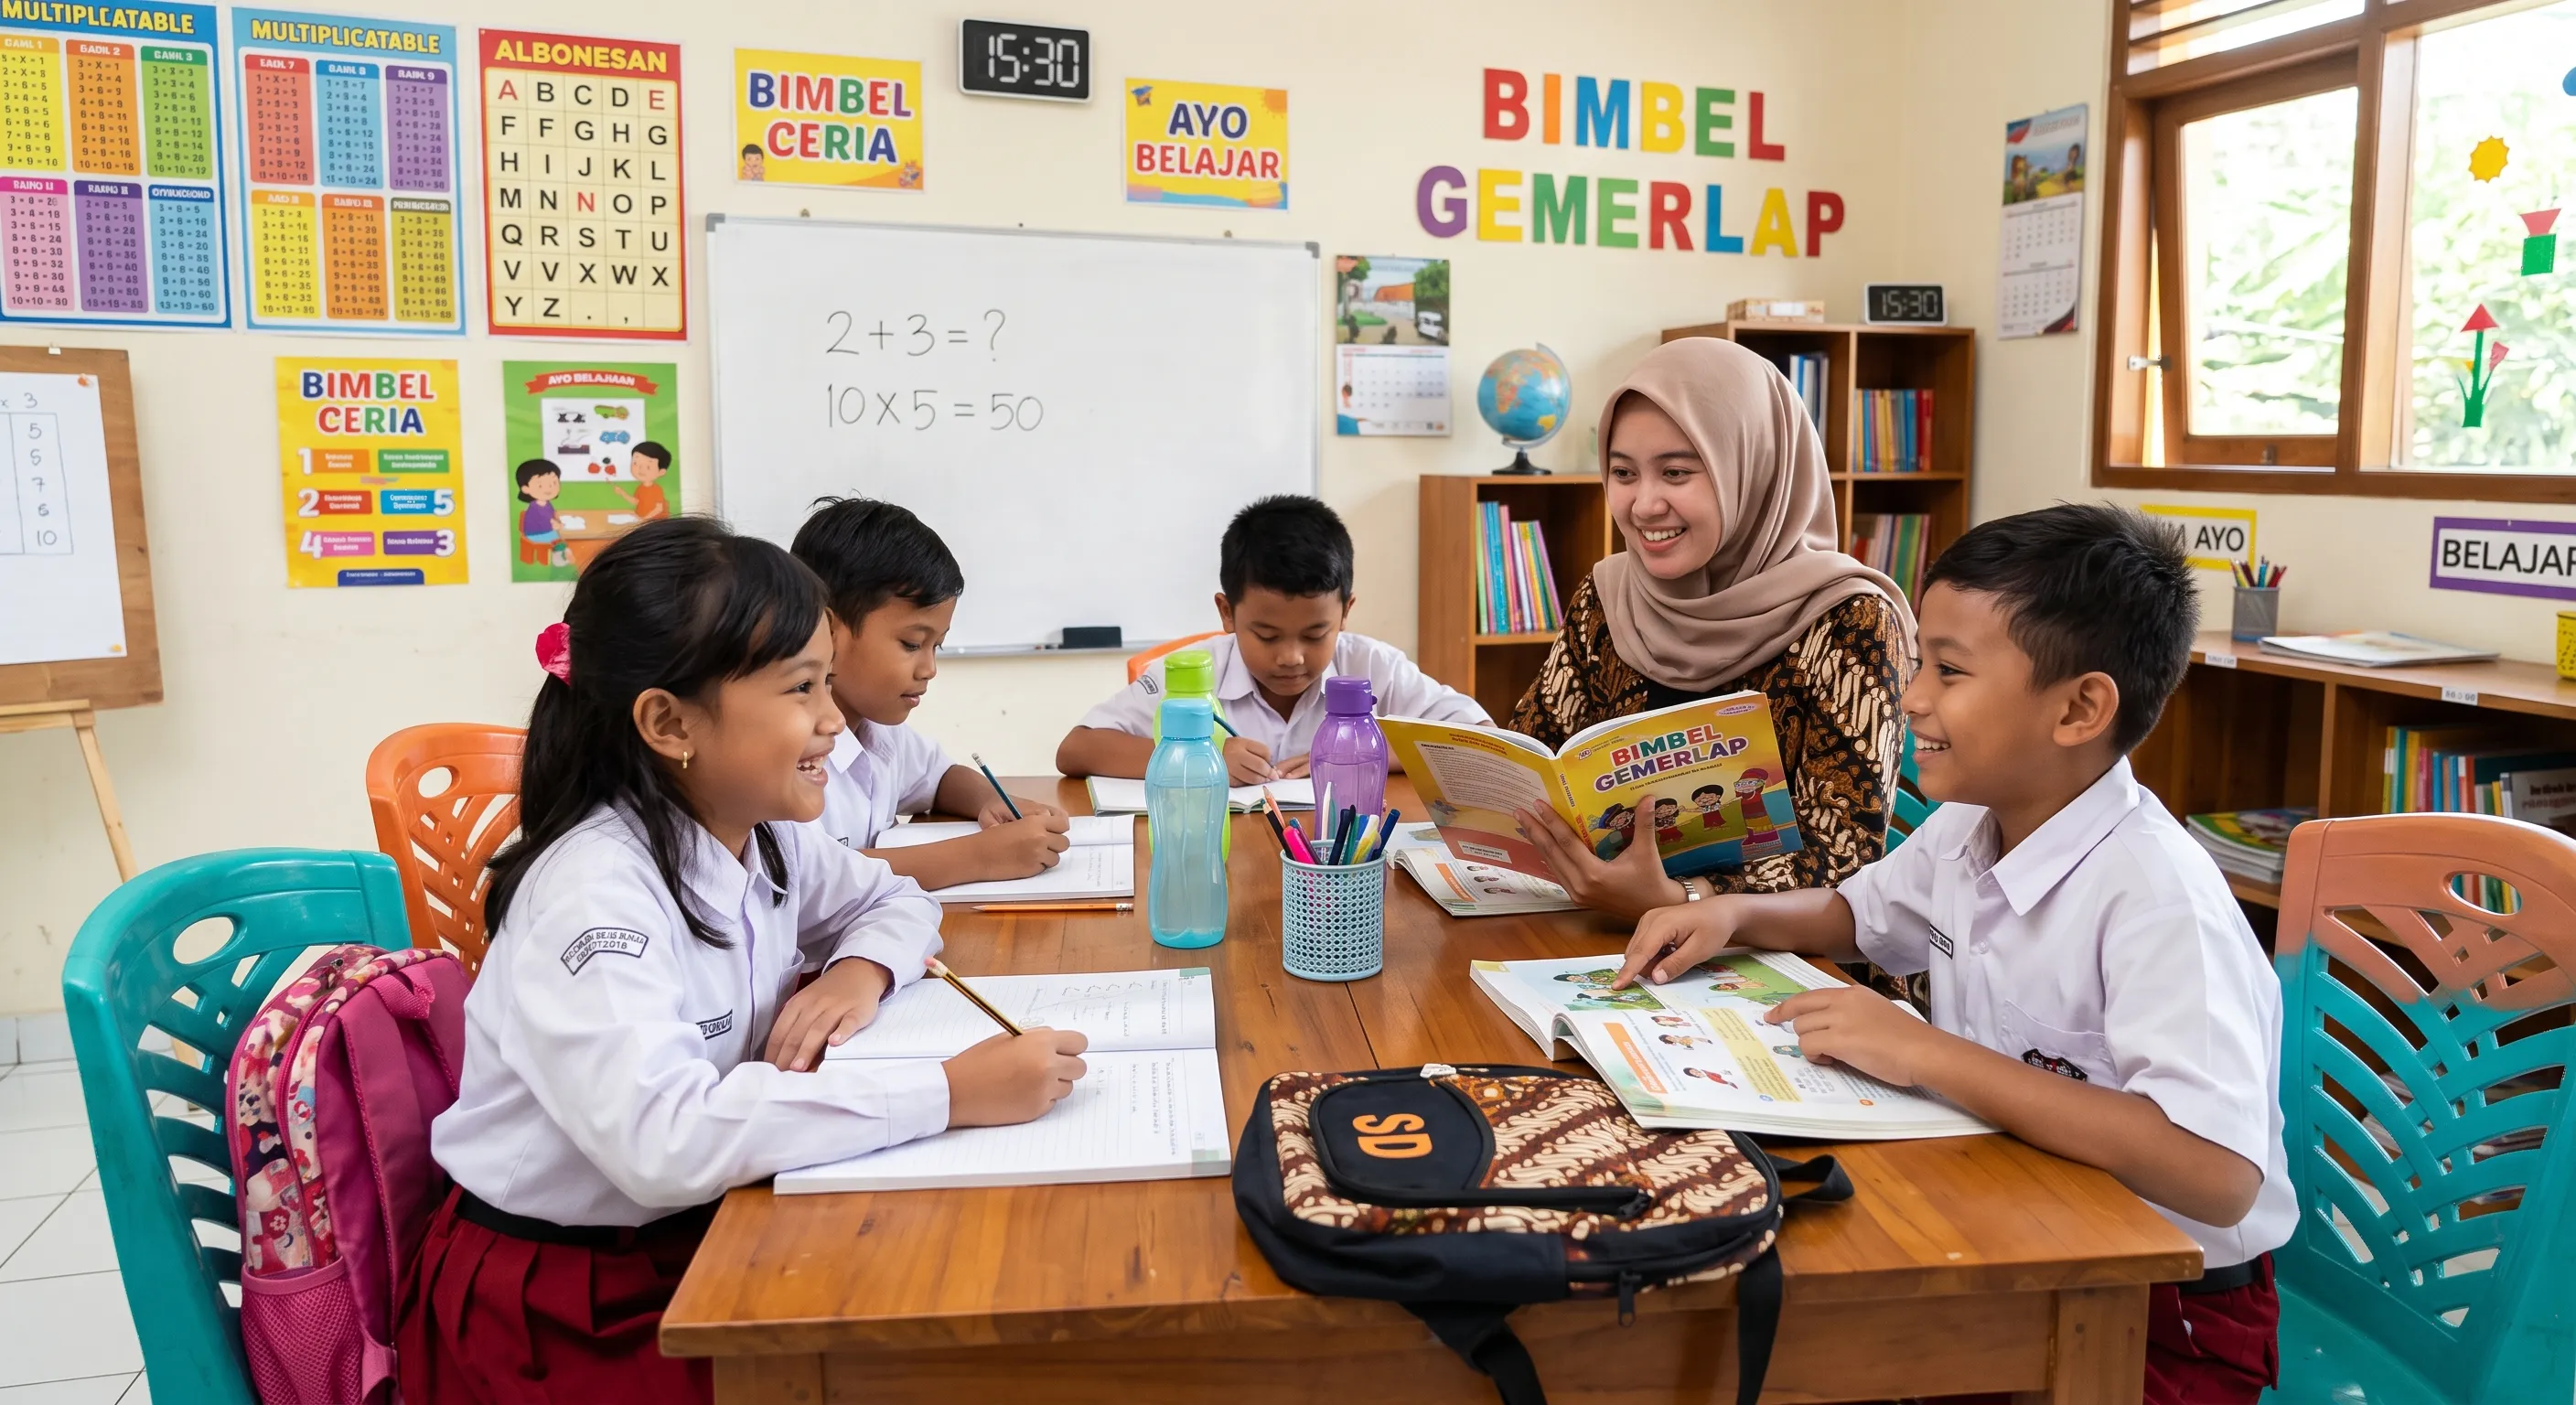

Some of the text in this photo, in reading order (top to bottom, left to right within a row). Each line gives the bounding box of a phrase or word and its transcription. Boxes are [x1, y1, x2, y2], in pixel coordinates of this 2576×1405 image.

[251, 19, 441, 53] MULTIPLICATABLE
[494, 39, 667, 73] ALBONESAN
[989, 33, 1079, 88] 15:30
[498, 80, 664, 110] A B C D E
[749, 71, 912, 118] BIMBEL
[1168, 102, 1248, 139] AYO
[1483, 68, 1786, 162] BIMBEL
[501, 115, 667, 145] F F G H G
[767, 122, 897, 164] CERIA
[501, 152, 666, 180] H I J K L
[1134, 144, 1280, 179] BELAJAR
[500, 188, 666, 215] M N N O P
[1416, 165, 1845, 259] GEMERLAP
[501, 224, 668, 251] Q R S T U
[503, 260, 669, 286] V V X W X
[505, 296, 523, 316] Y
[543, 298, 560, 317] Z
[1882, 290, 1938, 317] 15:30
[303, 371, 434, 400] BIMBEL
[548, 373, 572, 385] AYO
[24, 392, 38, 409] 3
[990, 392, 1044, 432] 50
[28, 423, 42, 440] 5
[318, 407, 424, 434] CERIA
[297, 447, 313, 475] 1
[31, 477, 46, 492] 7
[297, 488, 319, 517] 2
[434, 488, 456, 516] 5
[37, 530, 57, 547] 10
[299, 530, 323, 559] 4
[435, 529, 456, 556] 3
[2195, 525, 2244, 552] AYO
[1612, 724, 1722, 767] BIMBEL
[1595, 737, 1747, 791] GEMERLAP
[1352, 1113, 1433, 1159] SD
